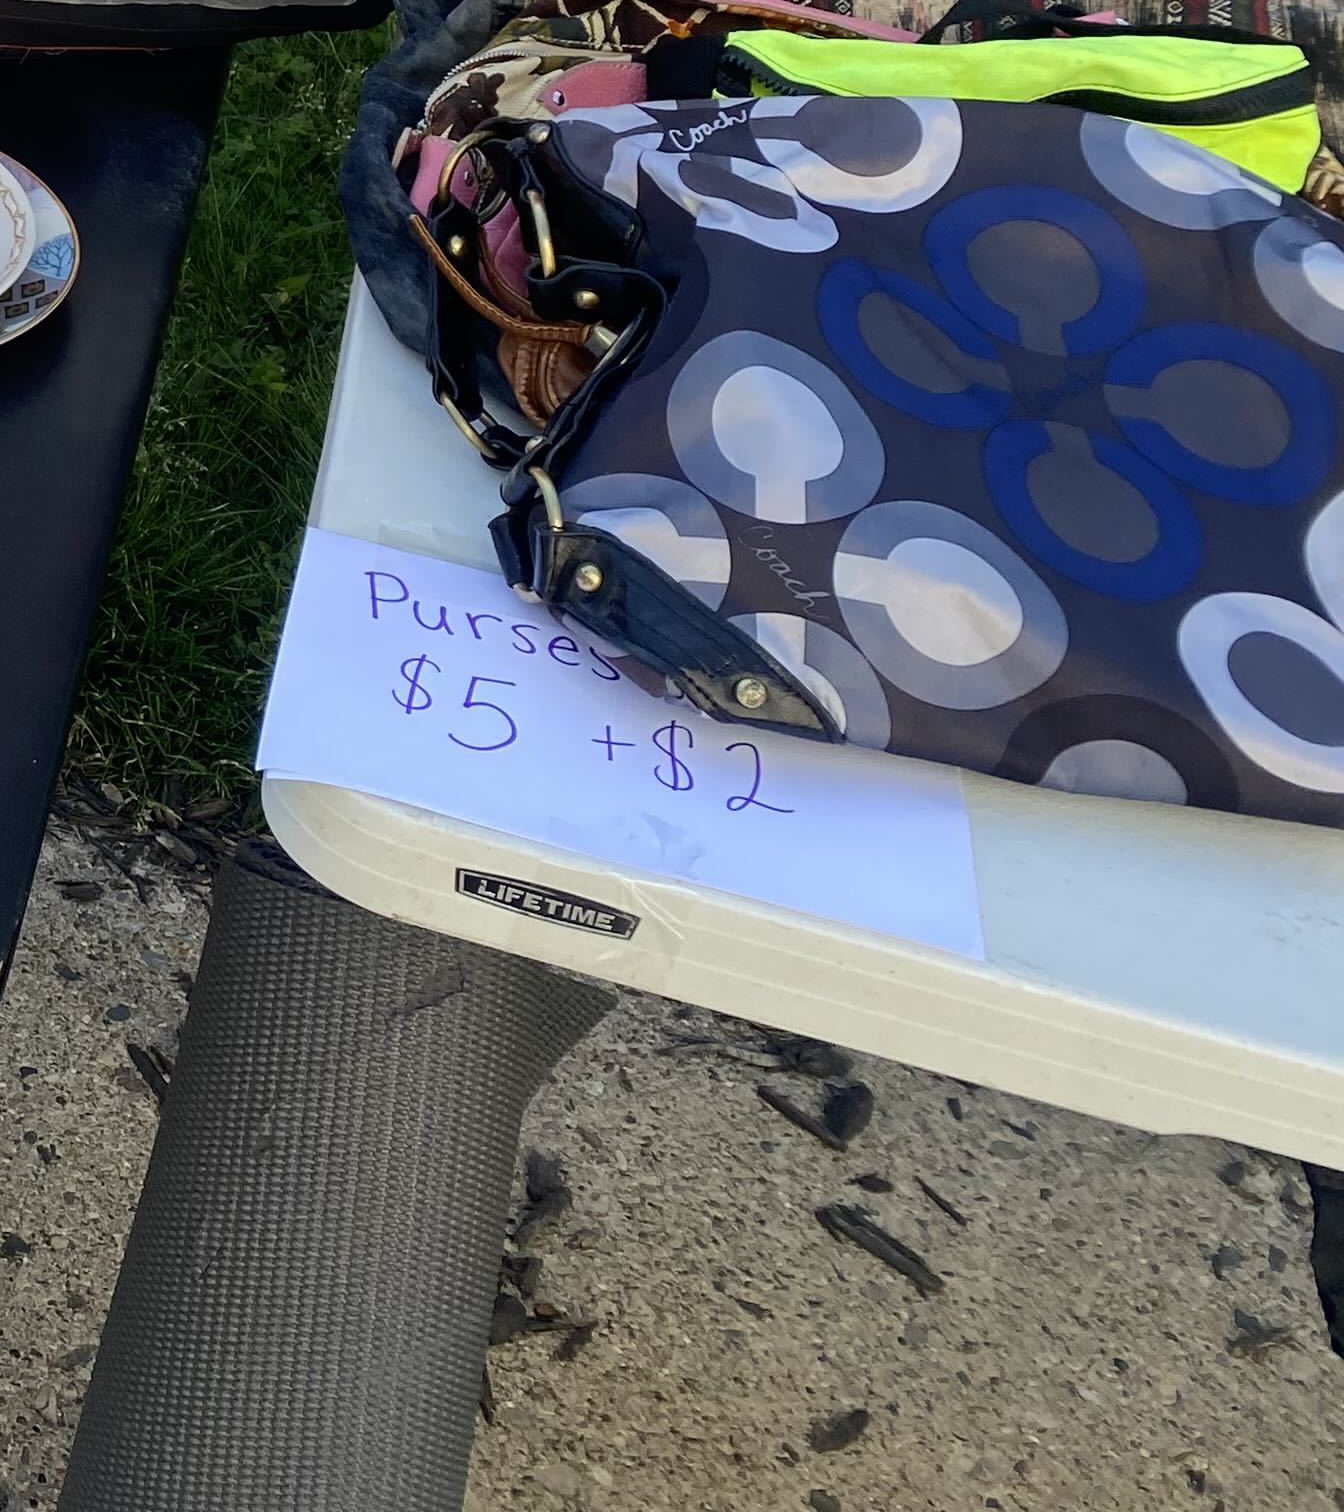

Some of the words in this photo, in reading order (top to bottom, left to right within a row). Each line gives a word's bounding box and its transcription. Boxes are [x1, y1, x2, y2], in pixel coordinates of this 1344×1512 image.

[668, 108, 748, 152] Coach
[737, 524, 831, 618] Coach
[362, 568, 625, 683] Purses
[390, 651, 520, 752] $5
[476, 878, 617, 931] LIFETIME
